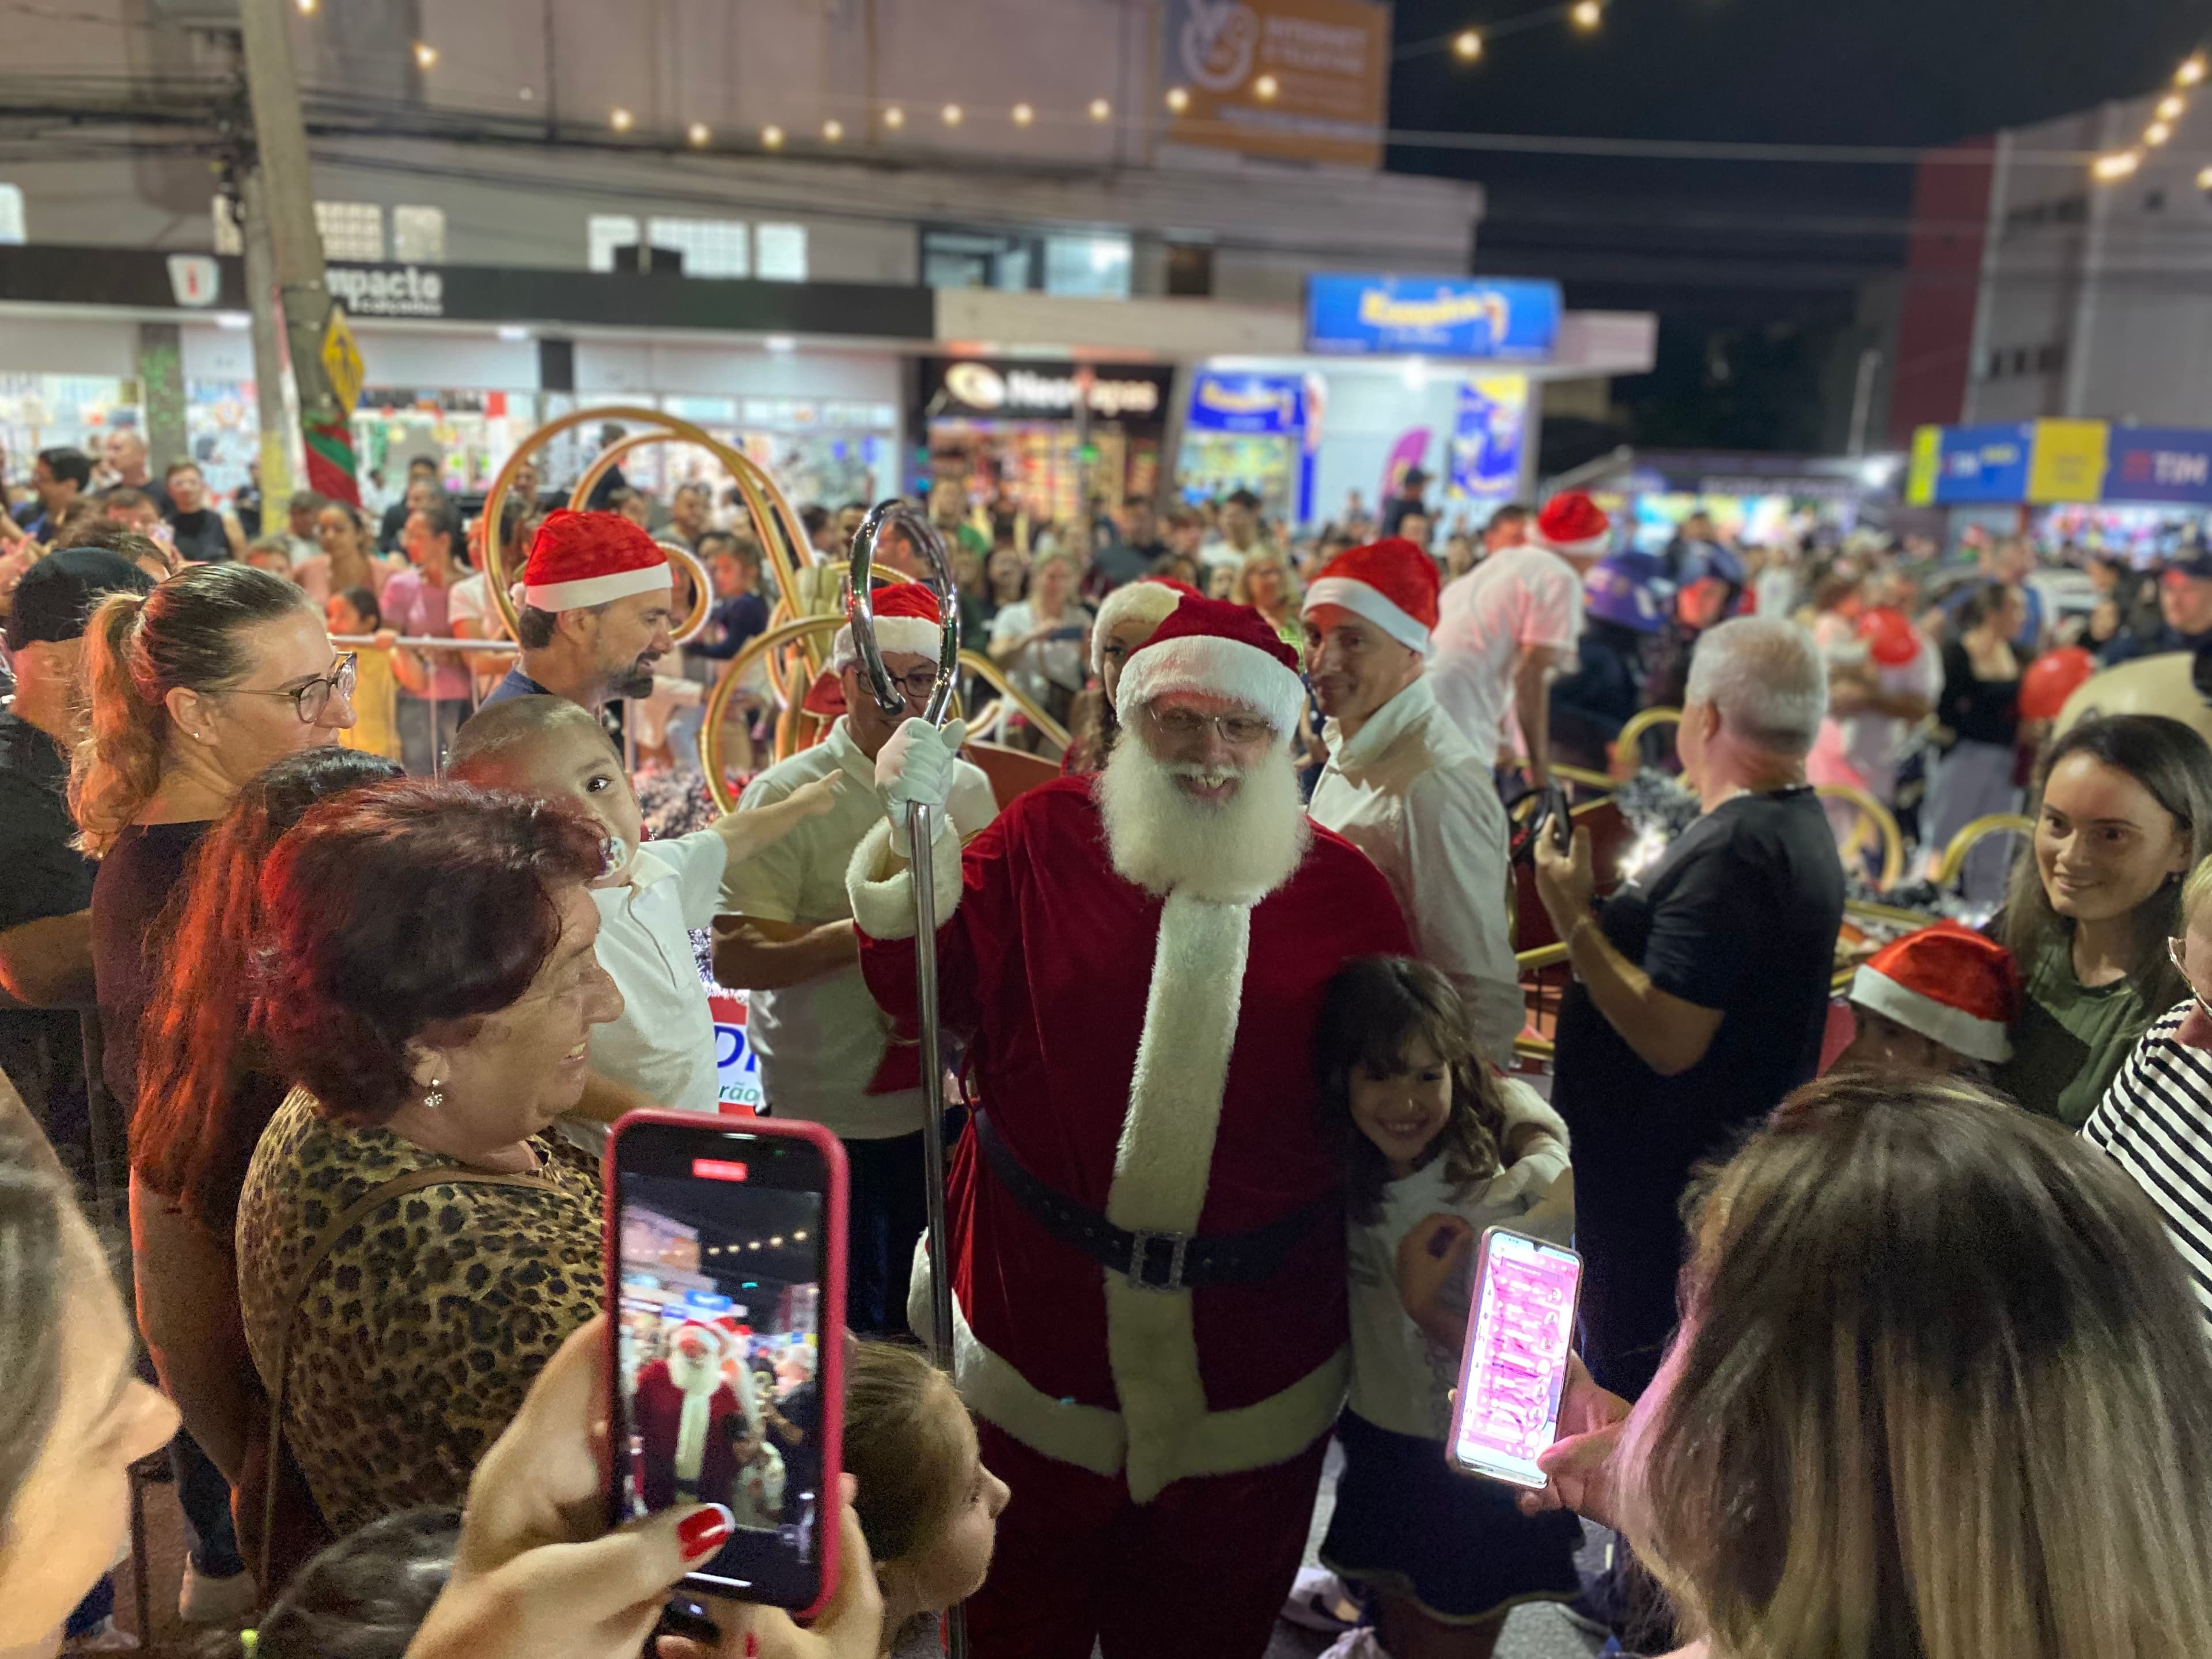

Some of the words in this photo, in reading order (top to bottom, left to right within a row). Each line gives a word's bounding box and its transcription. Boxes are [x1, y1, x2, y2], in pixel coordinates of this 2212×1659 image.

[325, 266, 442, 312] mpacto
[2156, 450, 2210, 485] TIM
[719, 1082, 759, 1102] rão
